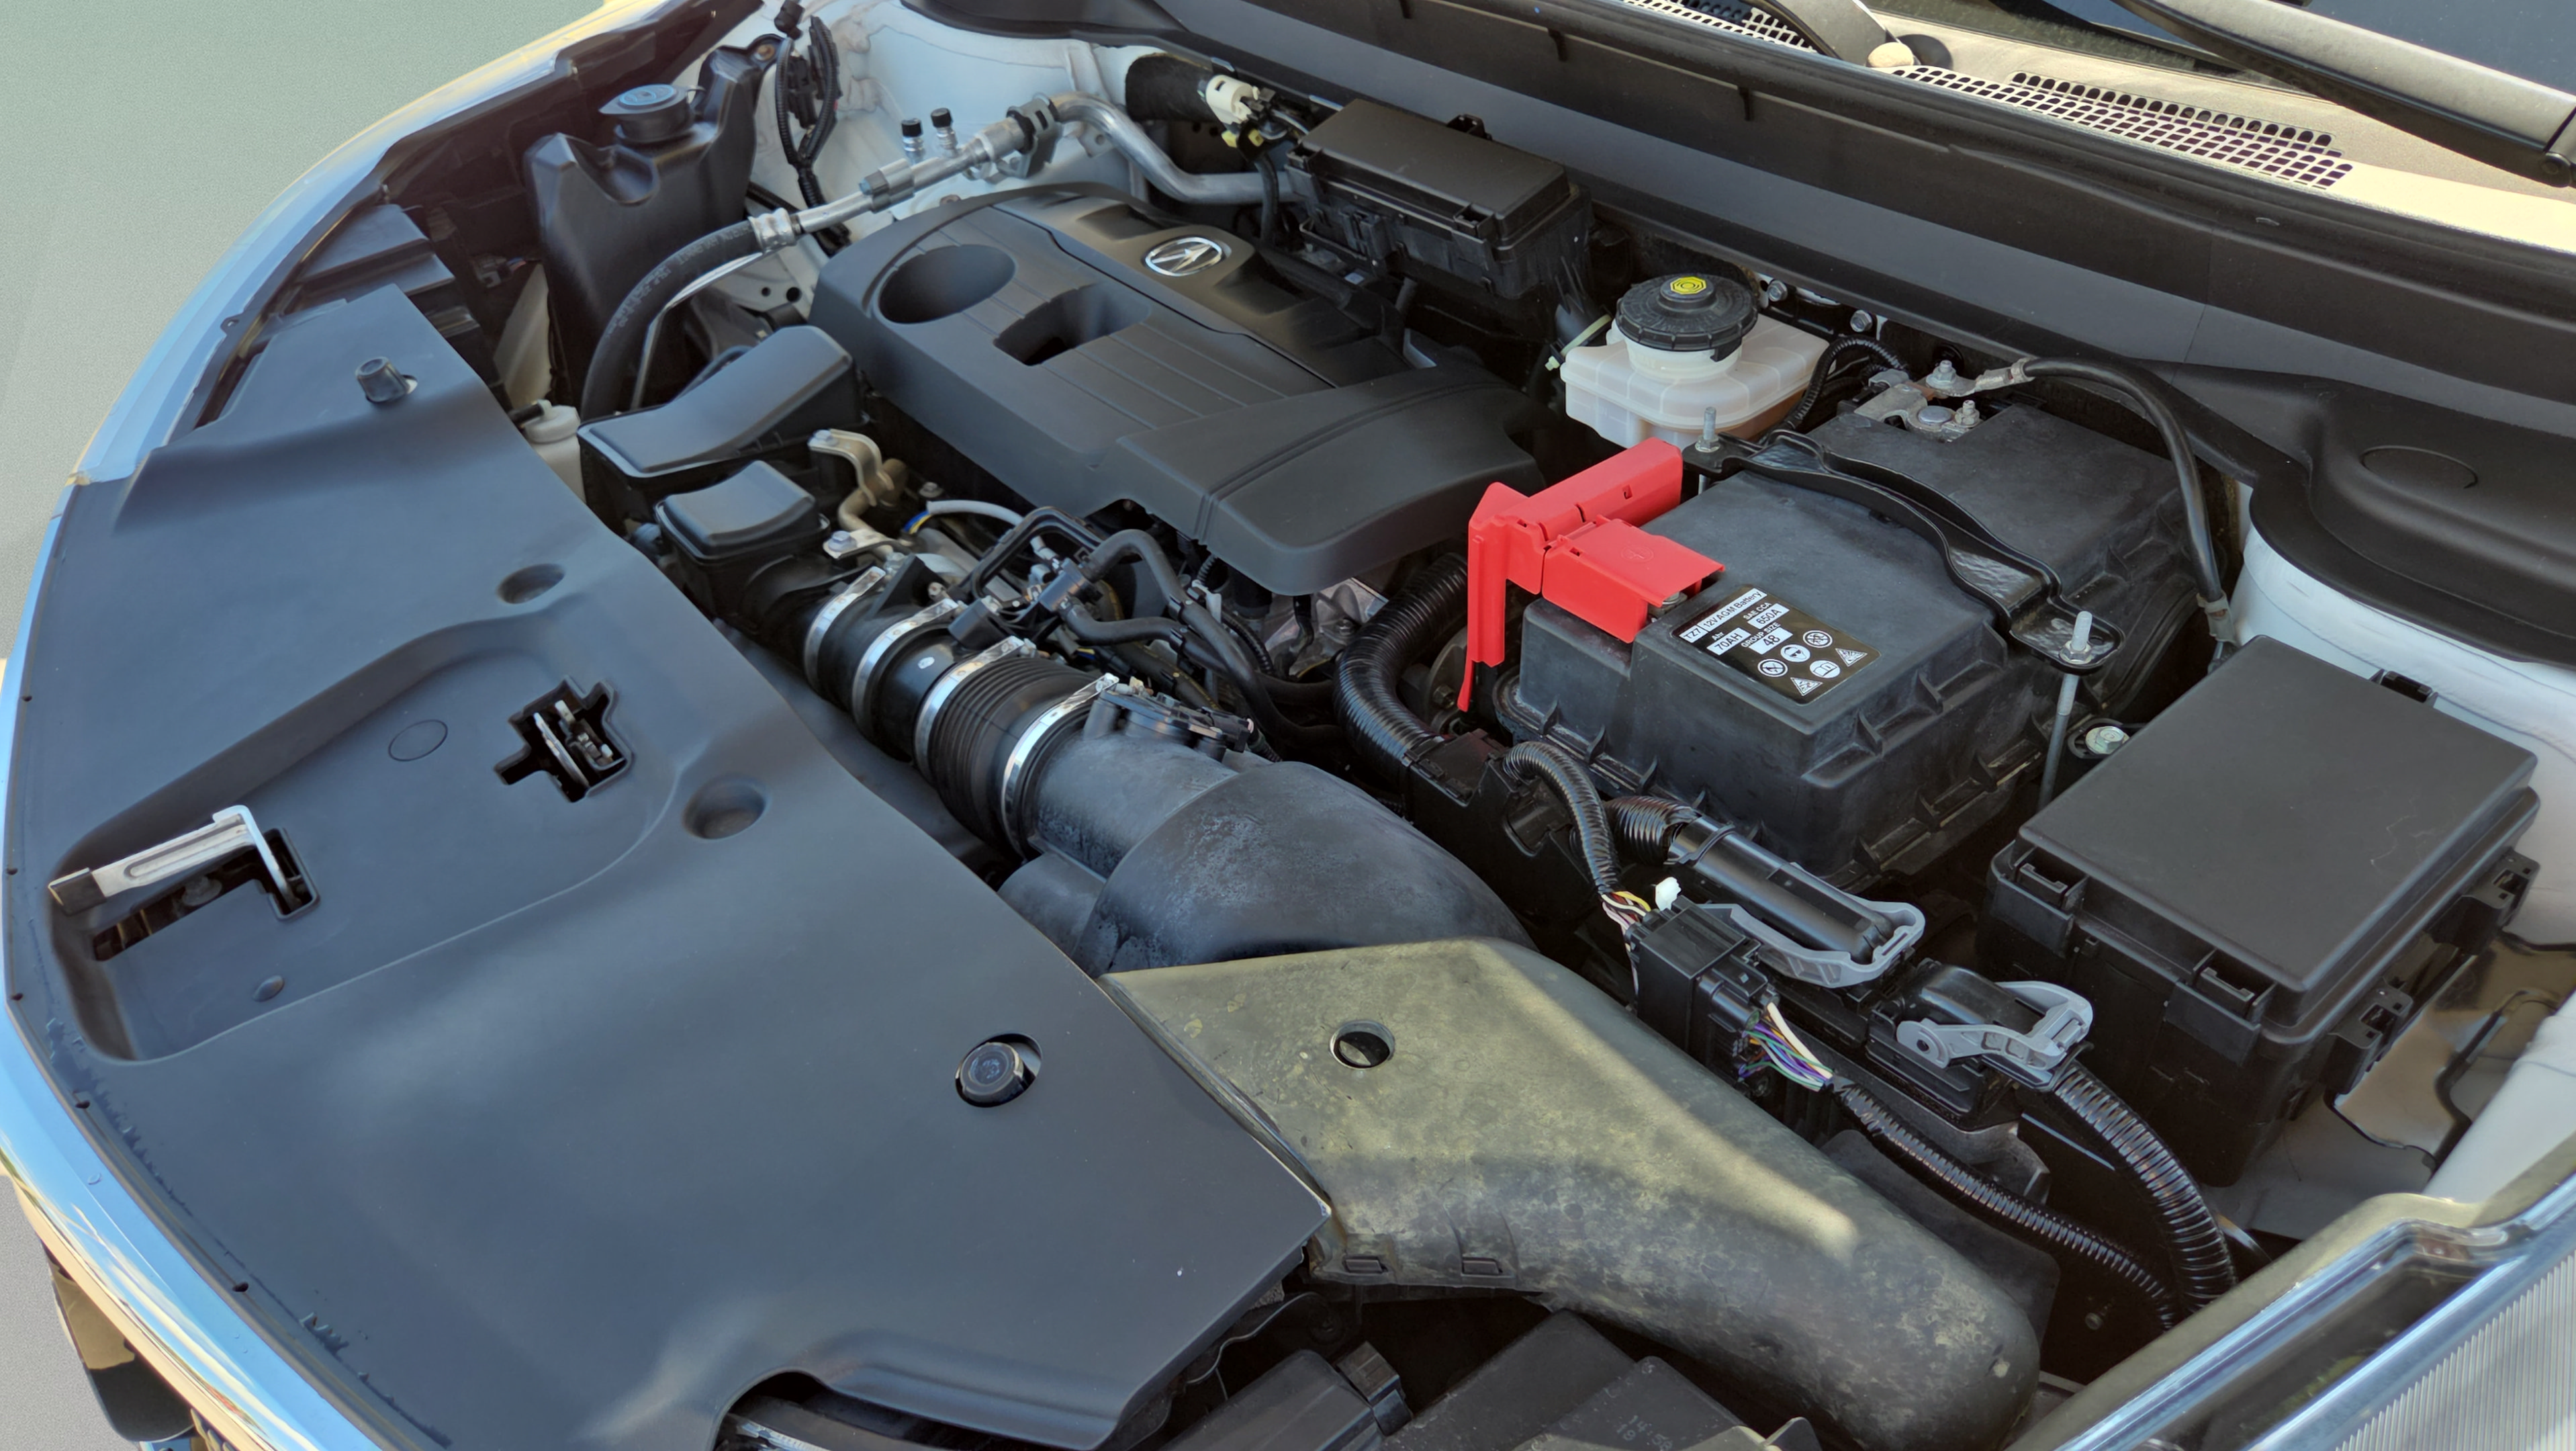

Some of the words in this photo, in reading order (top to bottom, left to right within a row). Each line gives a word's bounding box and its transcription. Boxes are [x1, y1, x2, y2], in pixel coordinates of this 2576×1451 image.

[1703, 617, 1718, 627] 12V
[1716, 606, 1737, 620] AGM
[1733, 591, 1762, 609] Battery
[1743, 610, 1759, 620] SAE
[1756, 602, 1772, 611] CCA
[1756, 609, 1782, 624] 650A
[1683, 627, 1702, 639] TZ7
[1714, 633, 1743, 650] 70AH
[1741, 631, 1765, 648] GROUP
[1763, 622, 1781, 633] SIZE
[1763, 635, 1781, 646] 48
